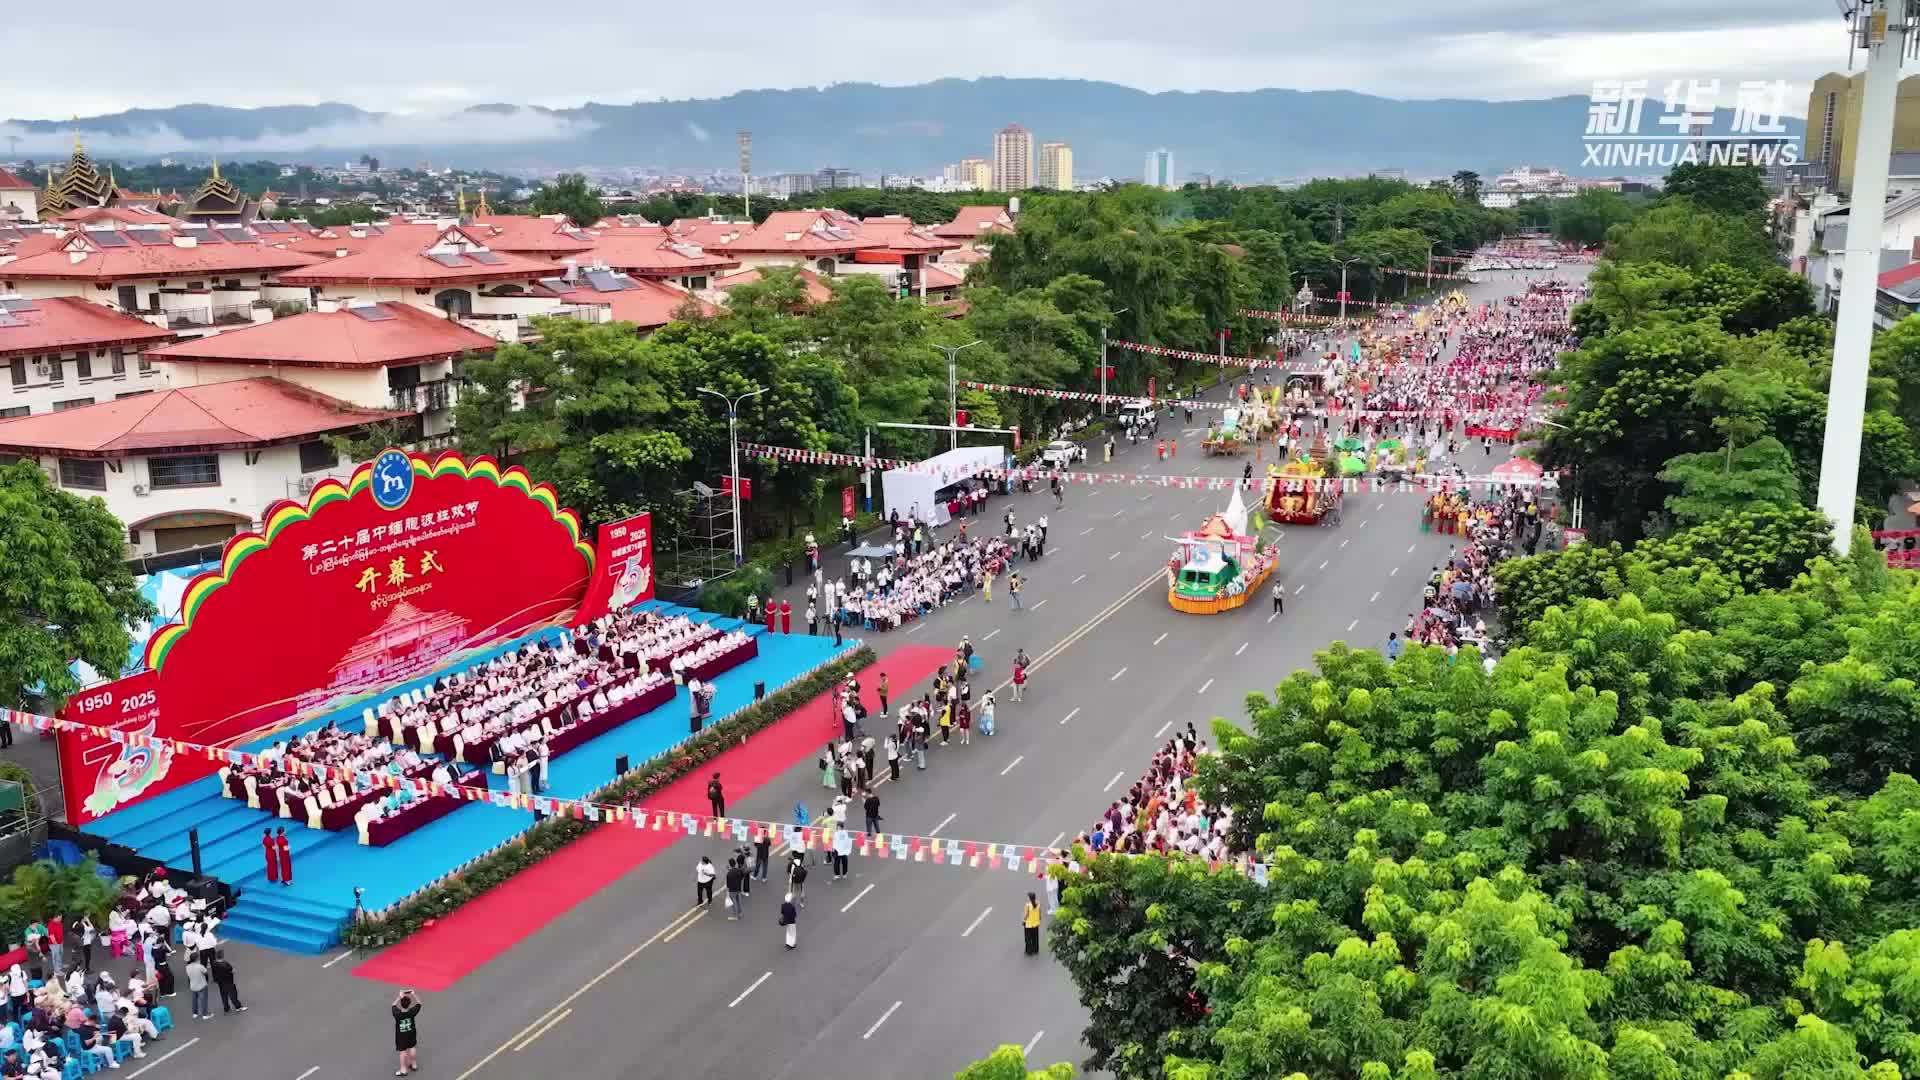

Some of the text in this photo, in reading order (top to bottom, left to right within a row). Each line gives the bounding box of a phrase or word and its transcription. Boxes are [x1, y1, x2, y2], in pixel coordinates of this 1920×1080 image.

[610, 526, 646, 542] 1950 2025
[355, 550, 444, 593] 开幕式
[77, 690, 156, 714] 1950 2025
